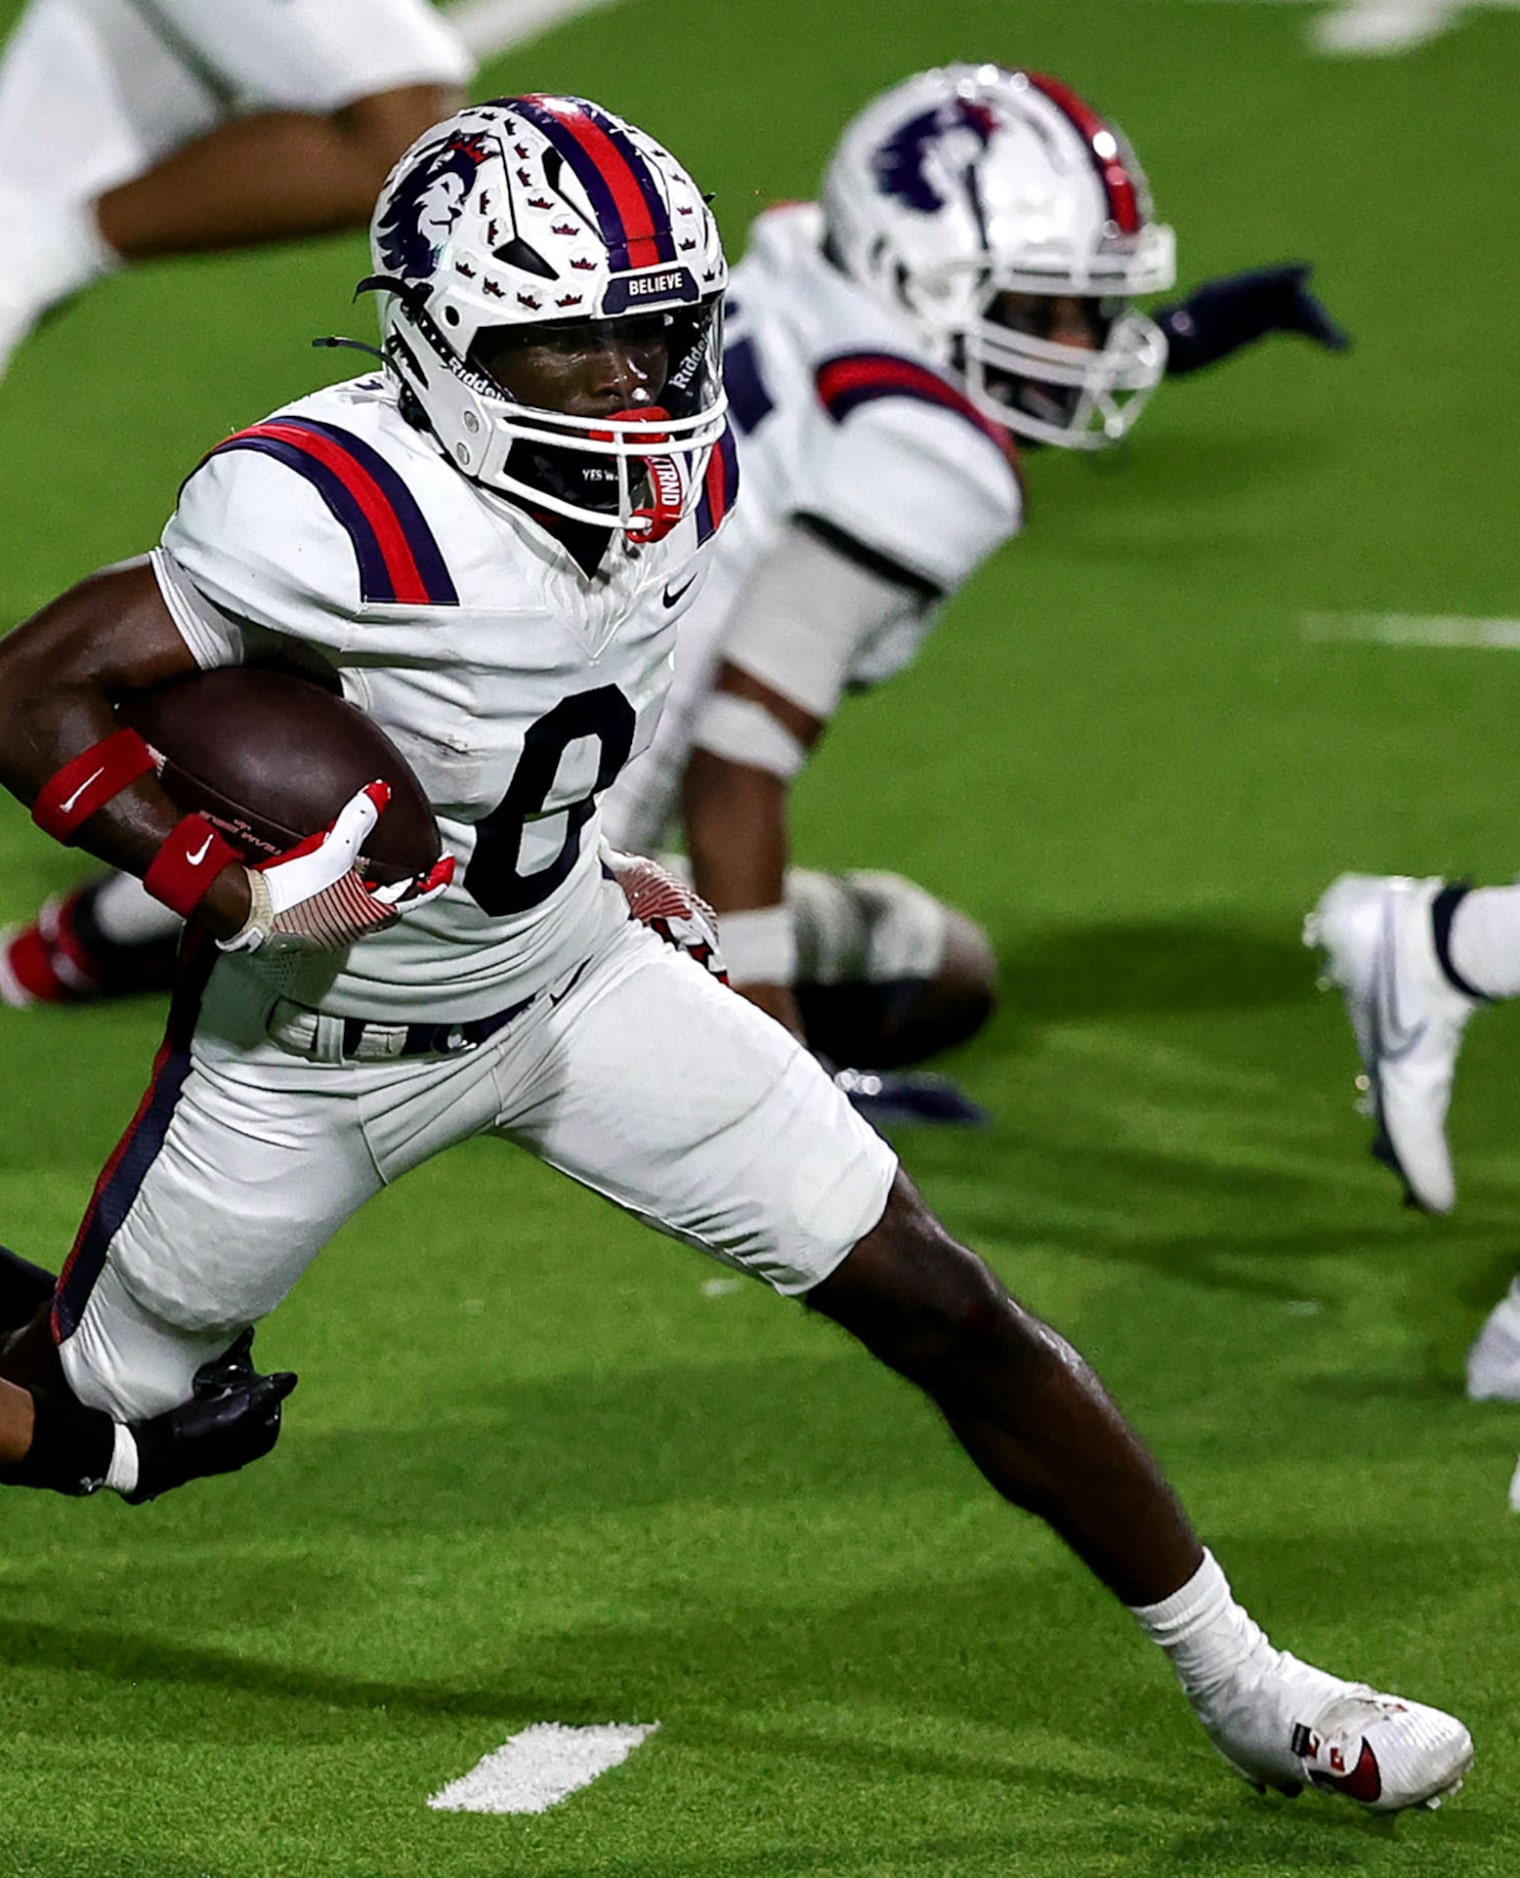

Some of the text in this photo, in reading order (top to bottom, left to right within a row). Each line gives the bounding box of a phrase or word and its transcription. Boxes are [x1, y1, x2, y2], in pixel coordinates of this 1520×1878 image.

[628, 271, 683, 296] BELIEVE
[448, 356, 506, 401] Ridde
[669, 332, 709, 390] Ridde
[582, 469, 603, 481] YES
